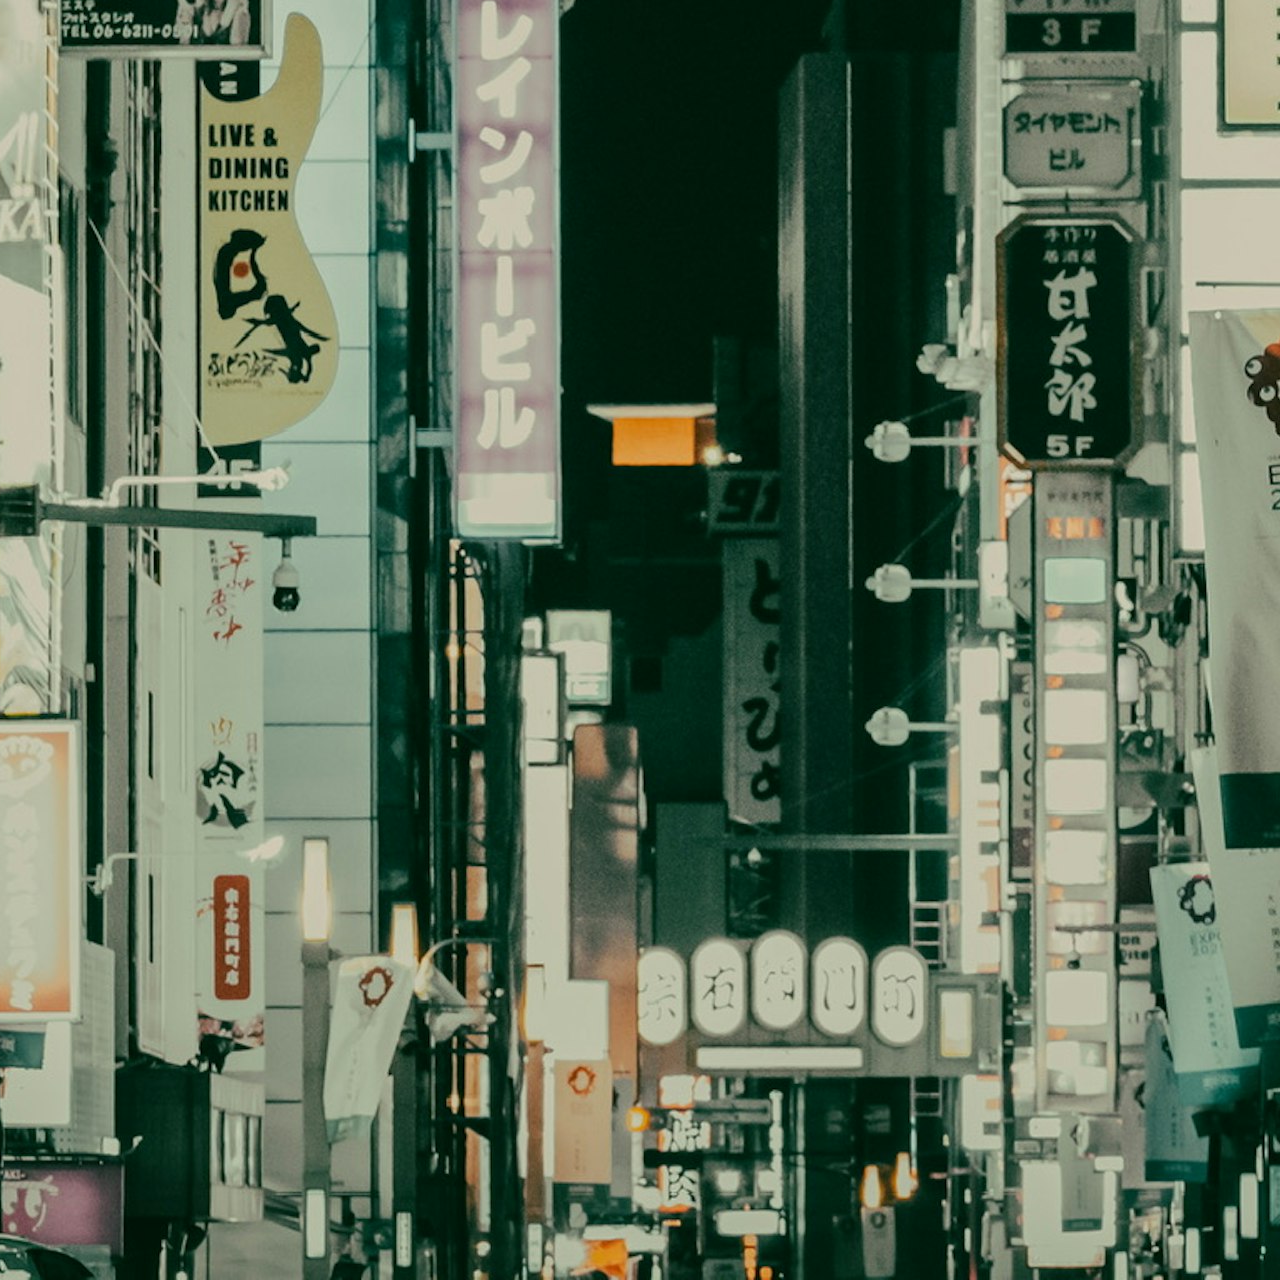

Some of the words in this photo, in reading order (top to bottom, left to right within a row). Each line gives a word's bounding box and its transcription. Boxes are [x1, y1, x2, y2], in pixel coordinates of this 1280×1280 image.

[209, 124, 254, 147] LIVE
[264, 129, 277, 146] &
[209, 157, 289, 179] DINING
[1049, 148, 1085, 172] ビル
[209, 189, 289, 211] KITCHEN
[477, 0, 535, 450] レインボービル
[1043, 266, 1098, 422] 甘太郎
[1046, 435, 1094, 458] 5F
